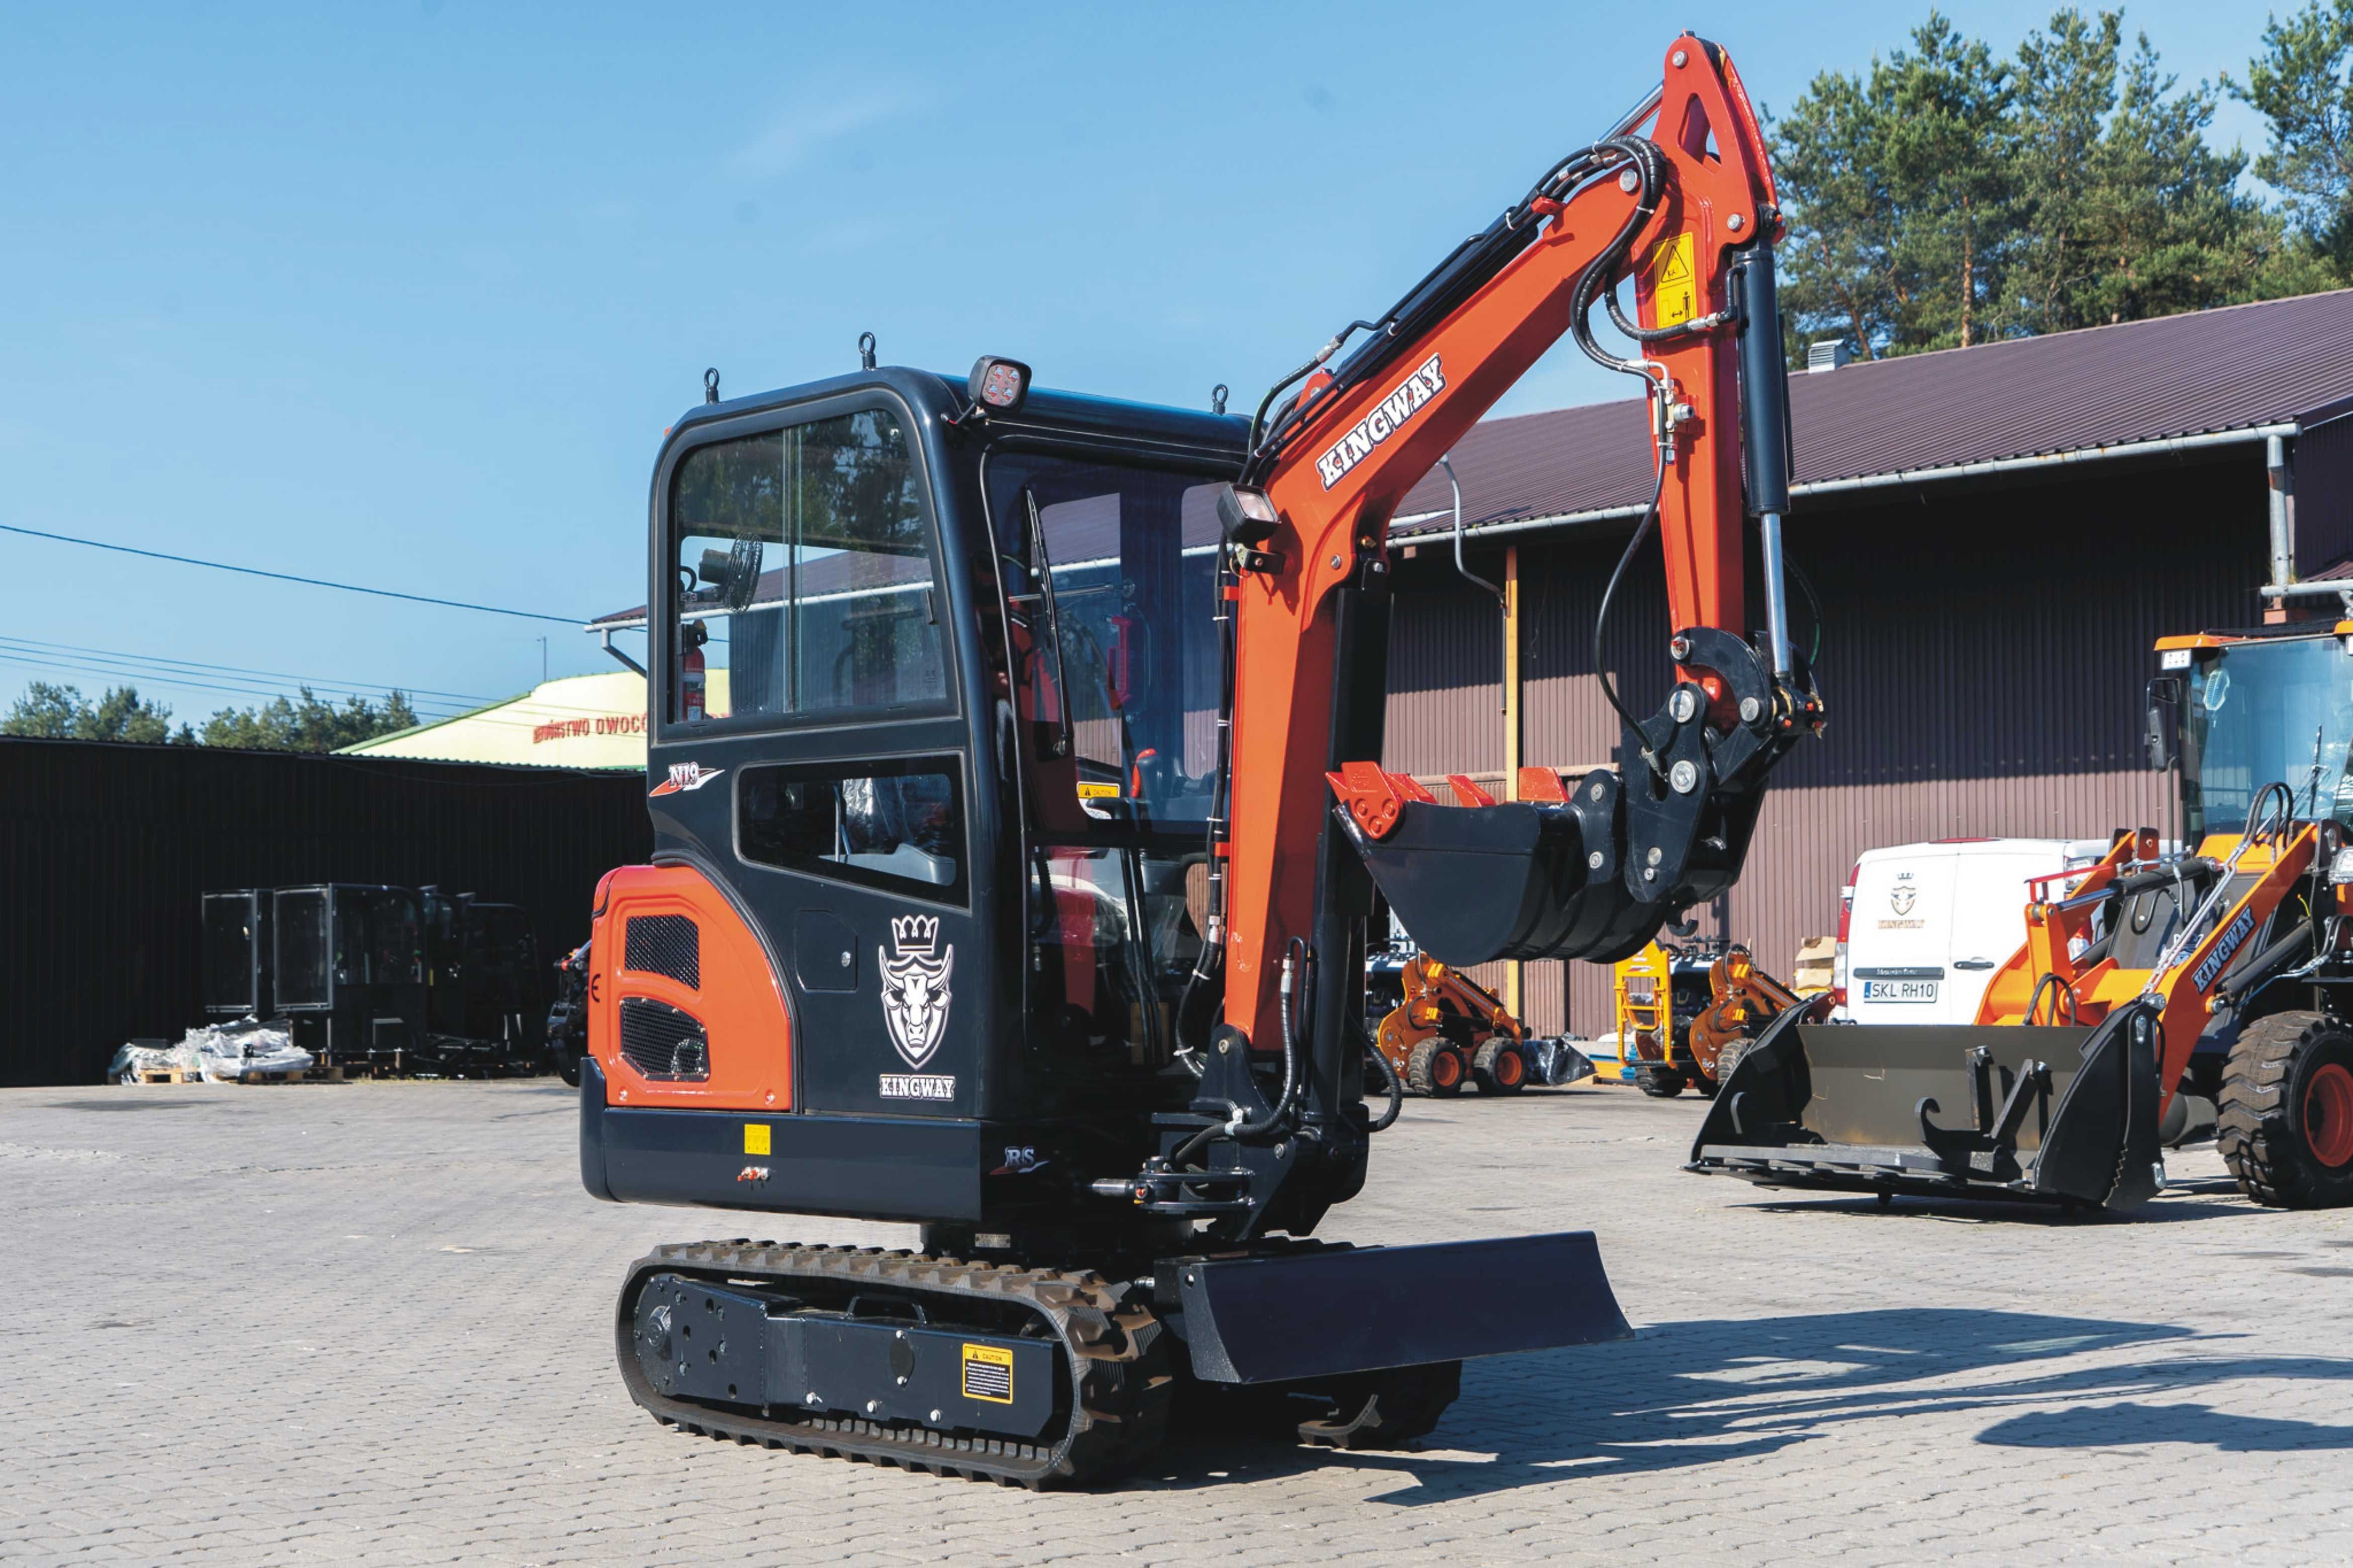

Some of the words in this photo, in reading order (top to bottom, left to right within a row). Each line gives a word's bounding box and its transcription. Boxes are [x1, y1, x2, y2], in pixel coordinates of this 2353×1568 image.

[1317, 354, 1445, 489] KINGWAY
[2193, 905, 2256, 994] KINGWAY
[1872, 984, 1897, 997] SKL
[1902, 984, 1934, 998] RH10
[880, 1075, 955, 1100] KINGWAY
[1005, 1146, 1034, 1167] RS
